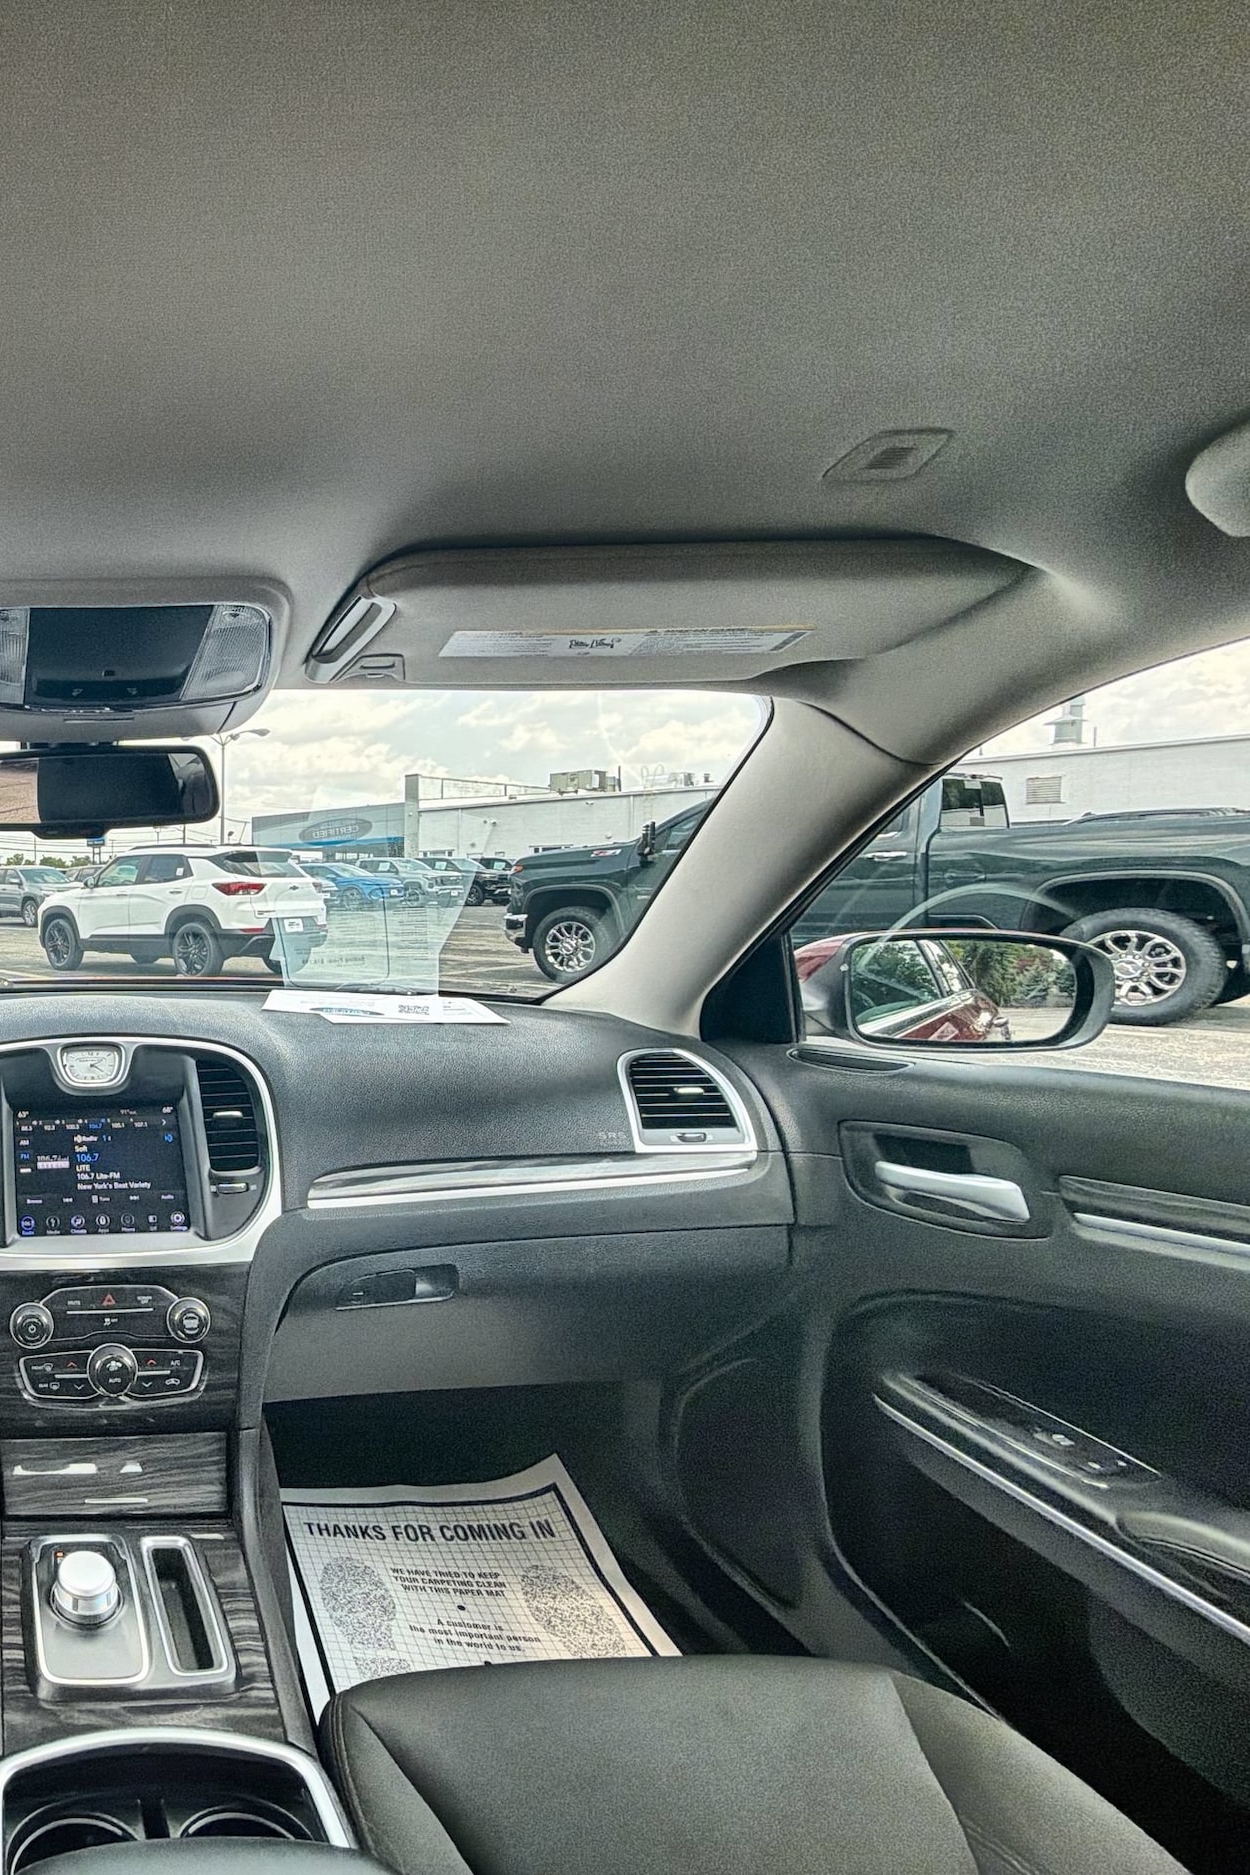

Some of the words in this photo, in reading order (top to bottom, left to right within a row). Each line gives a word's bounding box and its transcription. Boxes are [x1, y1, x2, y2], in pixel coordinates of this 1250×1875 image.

[76, 1153, 99, 1162] 106.7
[77, 1172, 94, 1180] 106.7
[114, 1181, 128, 1189] Best
[129, 1181, 151, 1189] Variety
[303, 1522, 386, 1541] THANKS
[391, 1524, 435, 1542] FOR
[439, 1522, 527, 1541] COMING
[529, 1519, 555, 1539] IN
[390, 1567, 405, 1575] WE
[407, 1568, 431, 1577] HAVE
[433, 1570, 460, 1579] TRIED
[462, 1571, 475, 1579] TO
[477, 1571, 500, 1580] KEEP
[392, 1575, 419, 1584] YOUR
[421, 1577, 474, 1588] CARPETING
[476, 1580, 507, 1588] CLEAN
[401, 1584, 427, 1593] WITH
[429, 1585, 450, 1595] THIS
[452, 1588, 484, 1597] PAPER
[485, 1589, 506, 1598] MAT
[437, 1618, 444, 1627] A
[446, 1619, 491, 1631] customer
[494, 1623, 504, 1632] is
[409, 1624, 425, 1634] the
[428, 1627, 452, 1636] most
[455, 1628, 504, 1640] important
[506, 1634, 541, 1643] person
[434, 1637, 444, 1645] in
[446, 1638, 463, 1647] the
[465, 1641, 494, 1650] world
[495, 1642, 507, 1651] to
